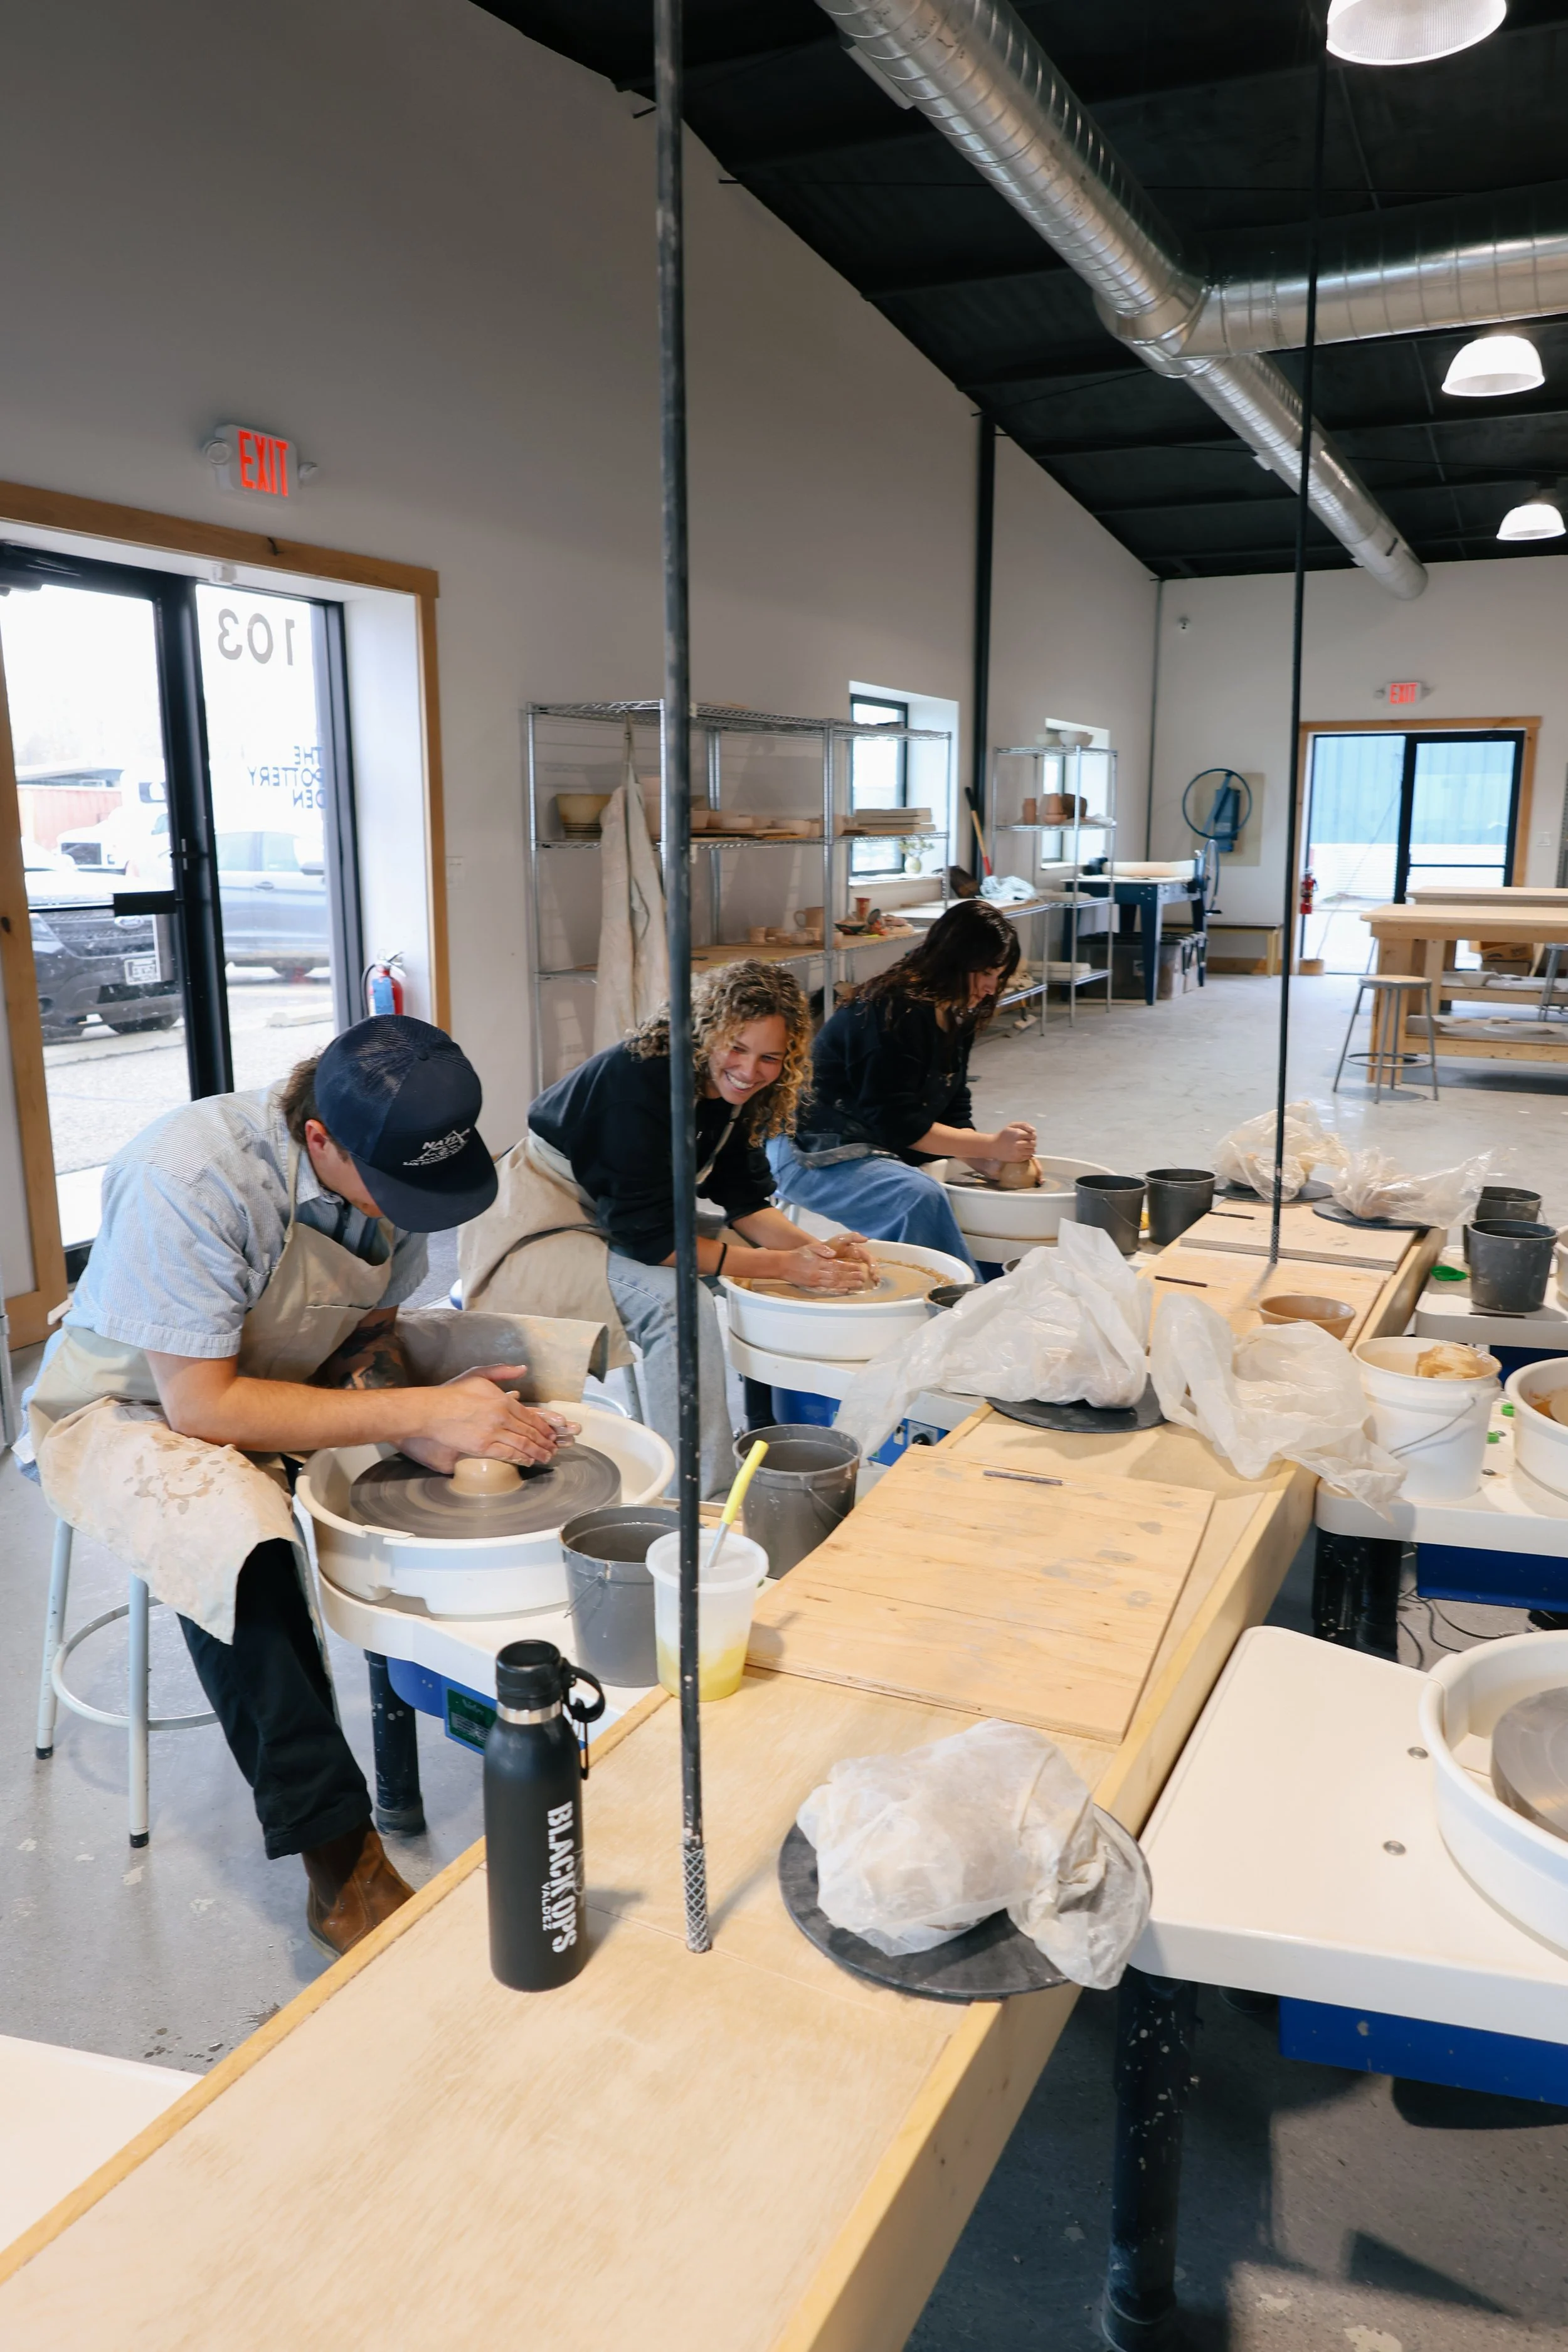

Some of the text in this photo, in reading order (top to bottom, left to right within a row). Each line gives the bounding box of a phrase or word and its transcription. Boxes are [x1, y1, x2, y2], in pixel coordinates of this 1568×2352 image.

[238, 429, 289, 497] EXIT
[1390, 682, 1418, 704] EXIT
[541, 1882, 553, 1931] VALDEZ
